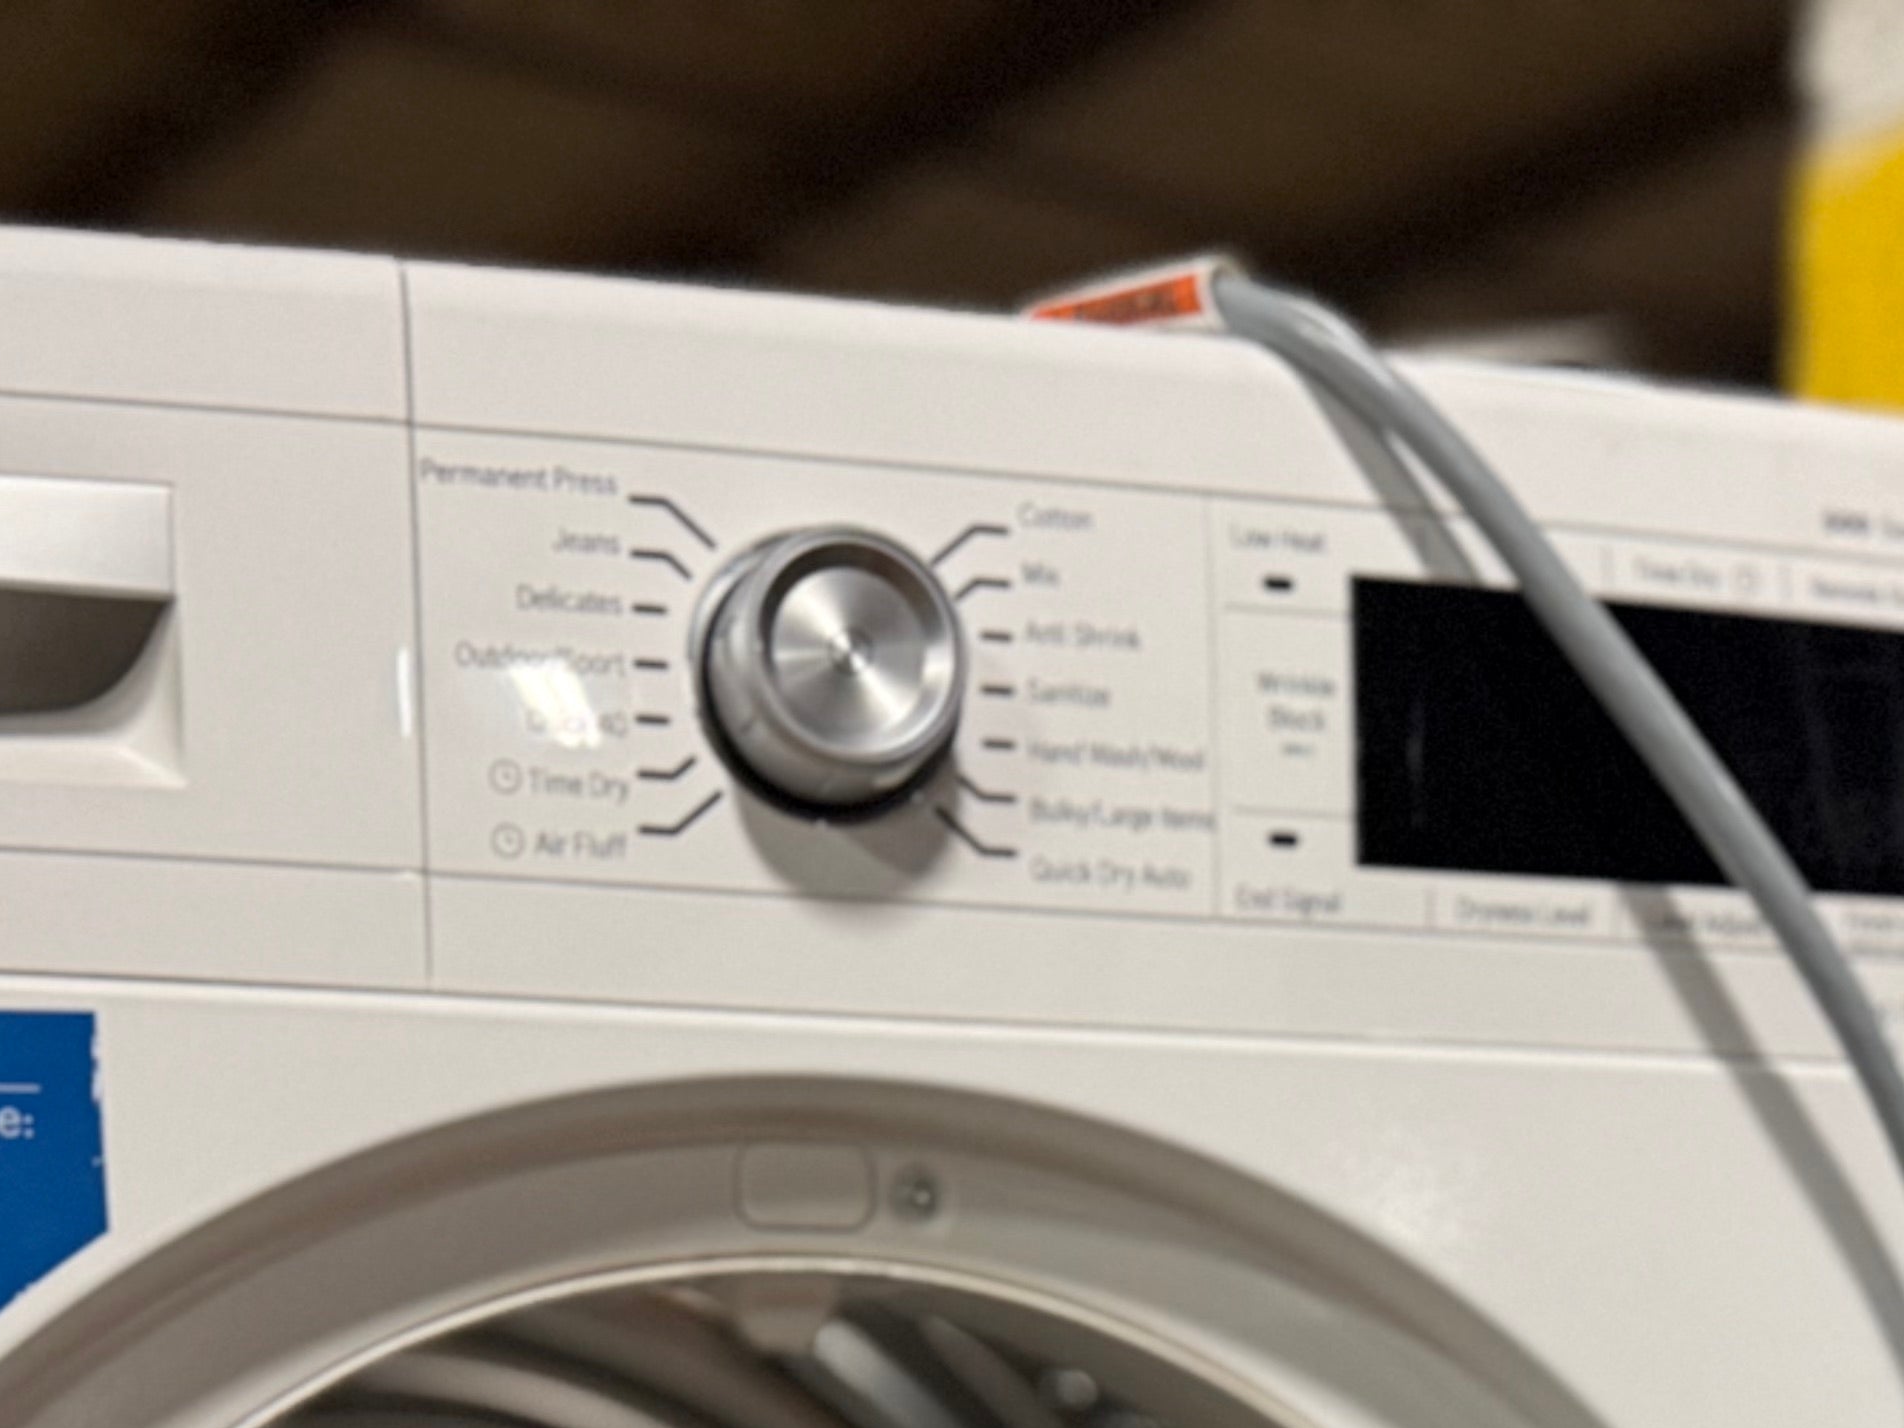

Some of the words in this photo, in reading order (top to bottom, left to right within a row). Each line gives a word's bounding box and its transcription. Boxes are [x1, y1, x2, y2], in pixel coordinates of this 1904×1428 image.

[420, 457, 546, 489] Permanent
[553, 466, 617, 495] Press
[552, 529, 619, 555] Jeans
[515, 584, 623, 614] Delicates
[529, 767, 583, 796] Time
[589, 770, 629, 806] Dry
[534, 831, 566, 855] Air
[572, 831, 628, 858] Fluff
